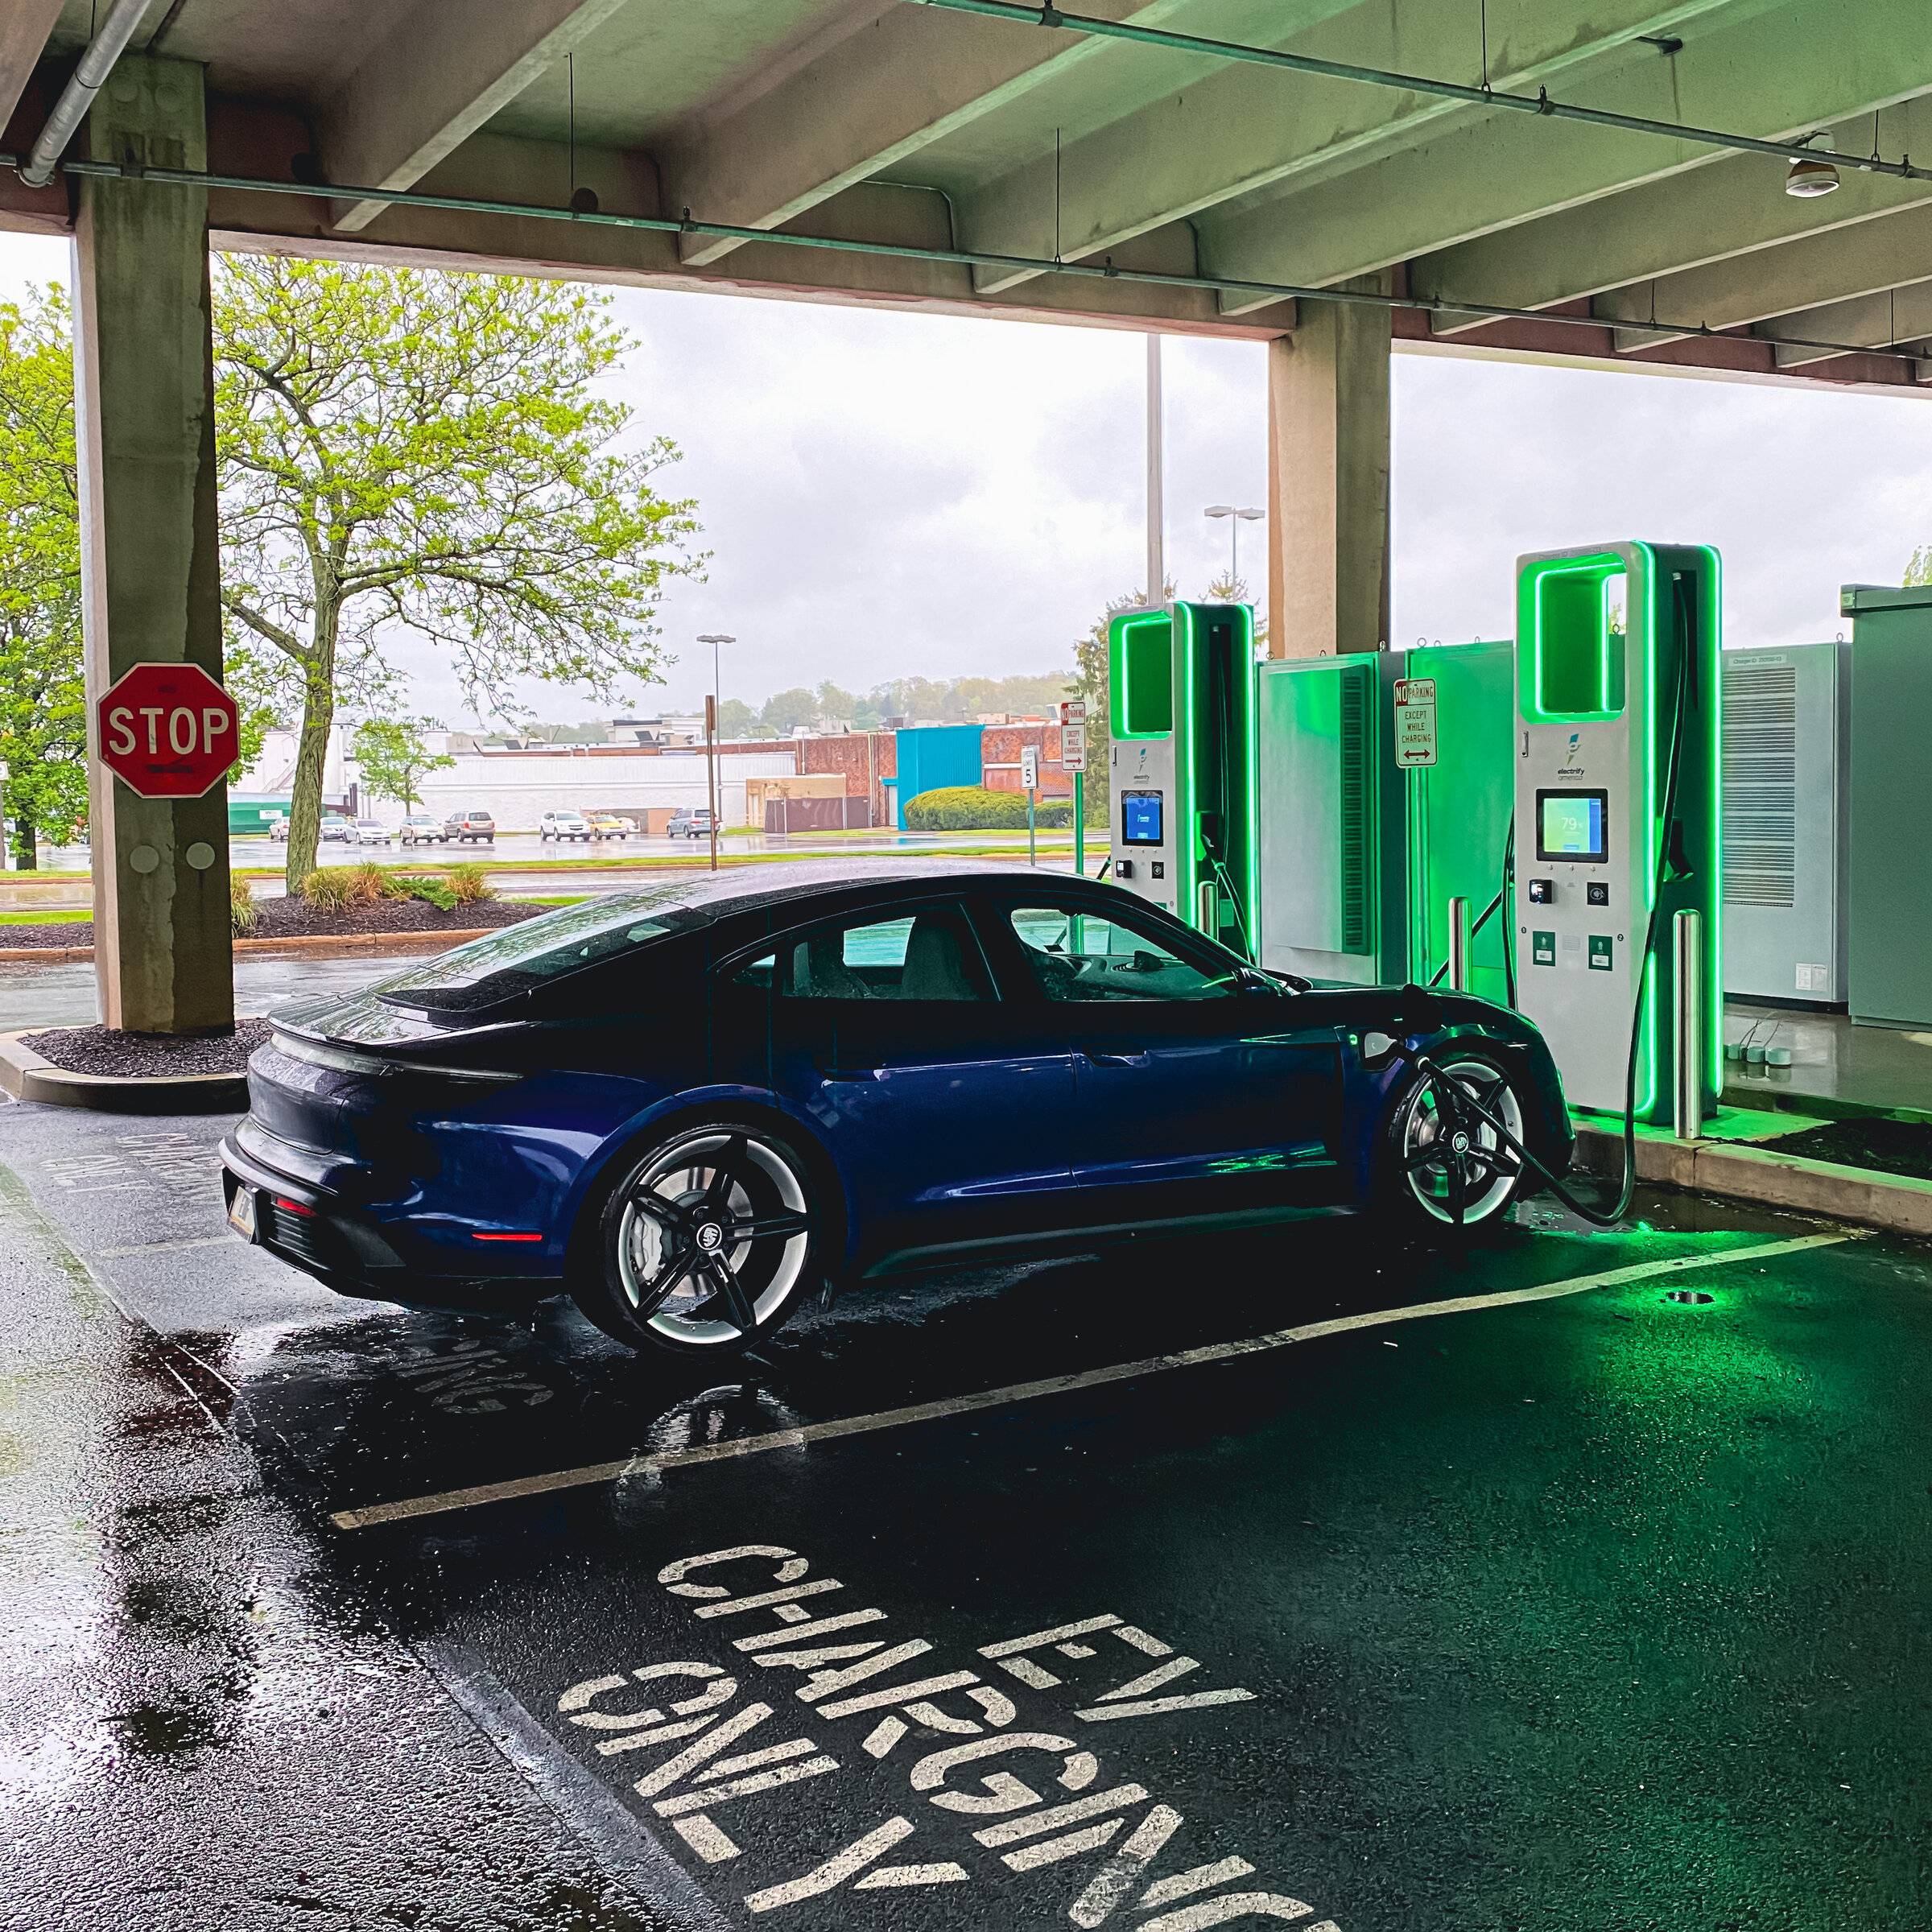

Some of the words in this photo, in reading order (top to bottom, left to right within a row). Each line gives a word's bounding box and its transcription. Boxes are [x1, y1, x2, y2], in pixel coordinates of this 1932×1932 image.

[1396, 685, 1408, 702] NO
[1408, 687, 1434, 698] PARKING
[1405, 710, 1426, 720] EXCEPT
[109, 707, 229, 755] STOP
[1406, 722, 1425, 731] WHILE
[1402, 733, 1431, 744] CHARGING
[1026, 769, 1031, 783] 5
[976, 1612, 1258, 1723] EV
[558, 1660, 970, 1913] ONLY
